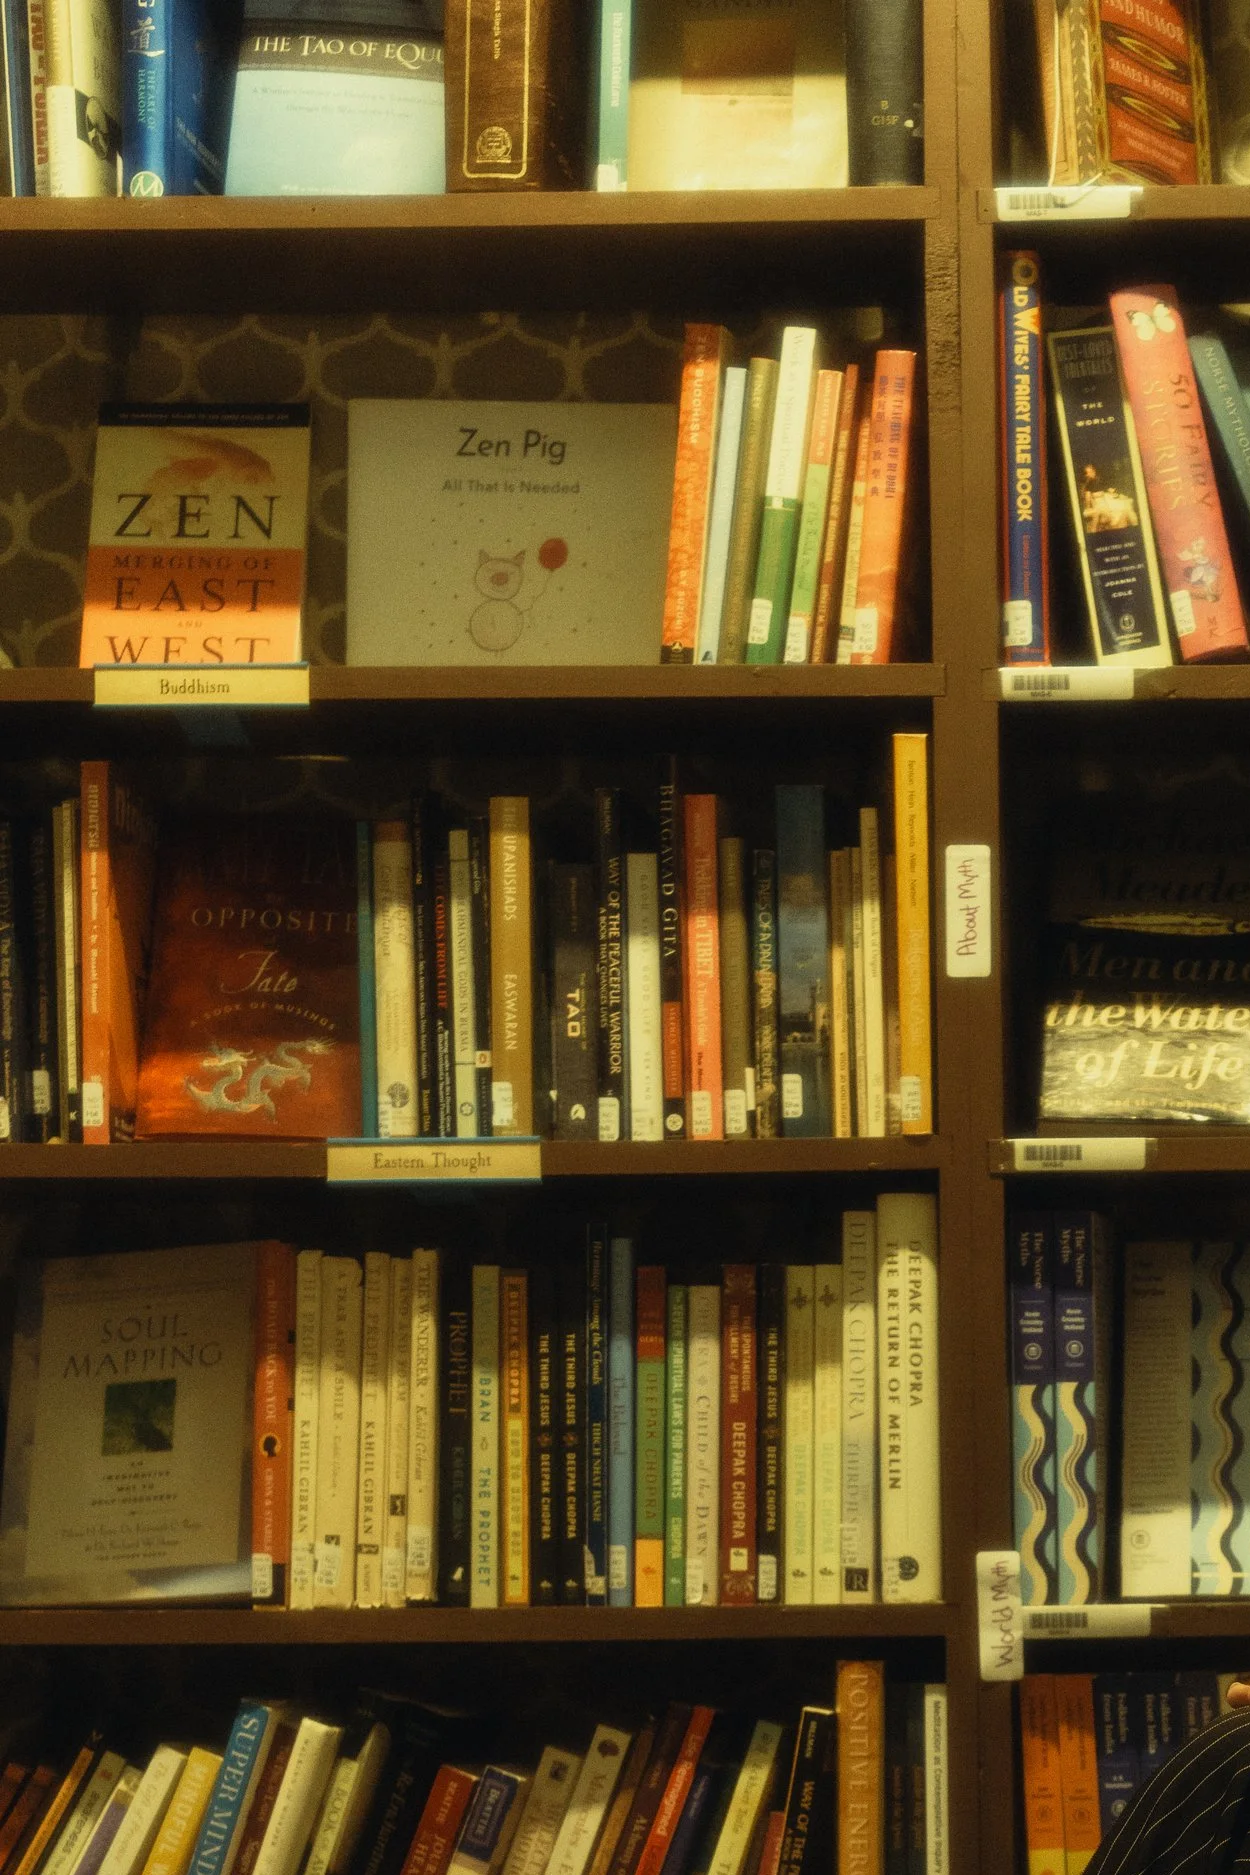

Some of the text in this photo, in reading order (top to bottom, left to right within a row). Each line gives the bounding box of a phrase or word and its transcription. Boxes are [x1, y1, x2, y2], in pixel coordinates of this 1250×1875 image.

[253, 36, 291, 52] THE
[298, 36, 344, 56] TAO
[349, 41, 376, 57] OF
[1204, 346, 1230, 393] NORSE
[455, 427, 568, 466] Zen Pig
[1142, 378, 1186, 513] STORIES
[442, 478, 463, 495] All
[466, 479, 494, 495] That
[518, 479, 581, 495] Needed
[114, 493, 281, 541] ZEN
[113, 576, 276, 613] EAST
[107, 635, 271, 664] WEST
[159, 677, 231, 696] Buddhism
[659, 784, 678, 958] BHAGAVAD GITA
[221, 949, 298, 994] Fate
[608, 857, 622, 1075] WAY OF THE PEACEFUL WARRIOR
[1060, 938, 1163, 981] Men
[504, 974, 517, 1050] EASWARAN
[1045, 989, 1127, 1029] the
[1075, 1038, 1246, 1091] of Life
[373, 1152, 492, 1172] Eastern Thought
[100, 1313, 188, 1344] SOUL
[416, 1264, 431, 1387] THE WANDERER
[766, 1328, 778, 1347] THE
[848, 1220, 866, 1421] DEEPAK CHOPRA
[908, 1240, 923, 1408] DEEPAK CHOPRA
[63, 1341, 223, 1378] MAPPING
[448, 1311, 468, 1418] PROPHET
[539, 1334, 551, 1426] THE THIRD JESUS
[565, 1333, 577, 1425] THE THIRD JESUS
[671, 1340, 683, 1395] SPIRITUAL
[766, 1349, 778, 1382] THIRD
[885, 1241, 902, 1490] THE RETURN OF MERLIN
[671, 1397, 683, 1426] LAWS
[766, 1385, 778, 1418] JESUS
[645, 1373, 662, 1520] DEEPAK CHOPRA
[672, 1428, 683, 1450] FOR
[298, 1419, 311, 1534] KAHLIL GIBRAN
[363, 1420, 376, 1535] KAHLIL GIBRAN
[540, 1453, 551, 1540] DEEPAK CHOPRA
[566, 1452, 577, 1539] DEEPAK CHOPRA
[672, 1452, 683, 1498] PARENTS
[732, 1422, 747, 1539] DEEPAK CHOPRA
[766, 1445, 777, 1532] DEEPAK CHOPRA
[478, 1467, 491, 1587] THE PROPHET
[994, 1559, 1015, 1668] World Myth
[215, 1713, 260, 1803] SUPER
[848, 1673, 871, 1791] POSITIVE
[800, 1780, 816, 1810] WAY
[792, 1836, 809, 1862] THE
[796, 1814, 811, 1833] OF
